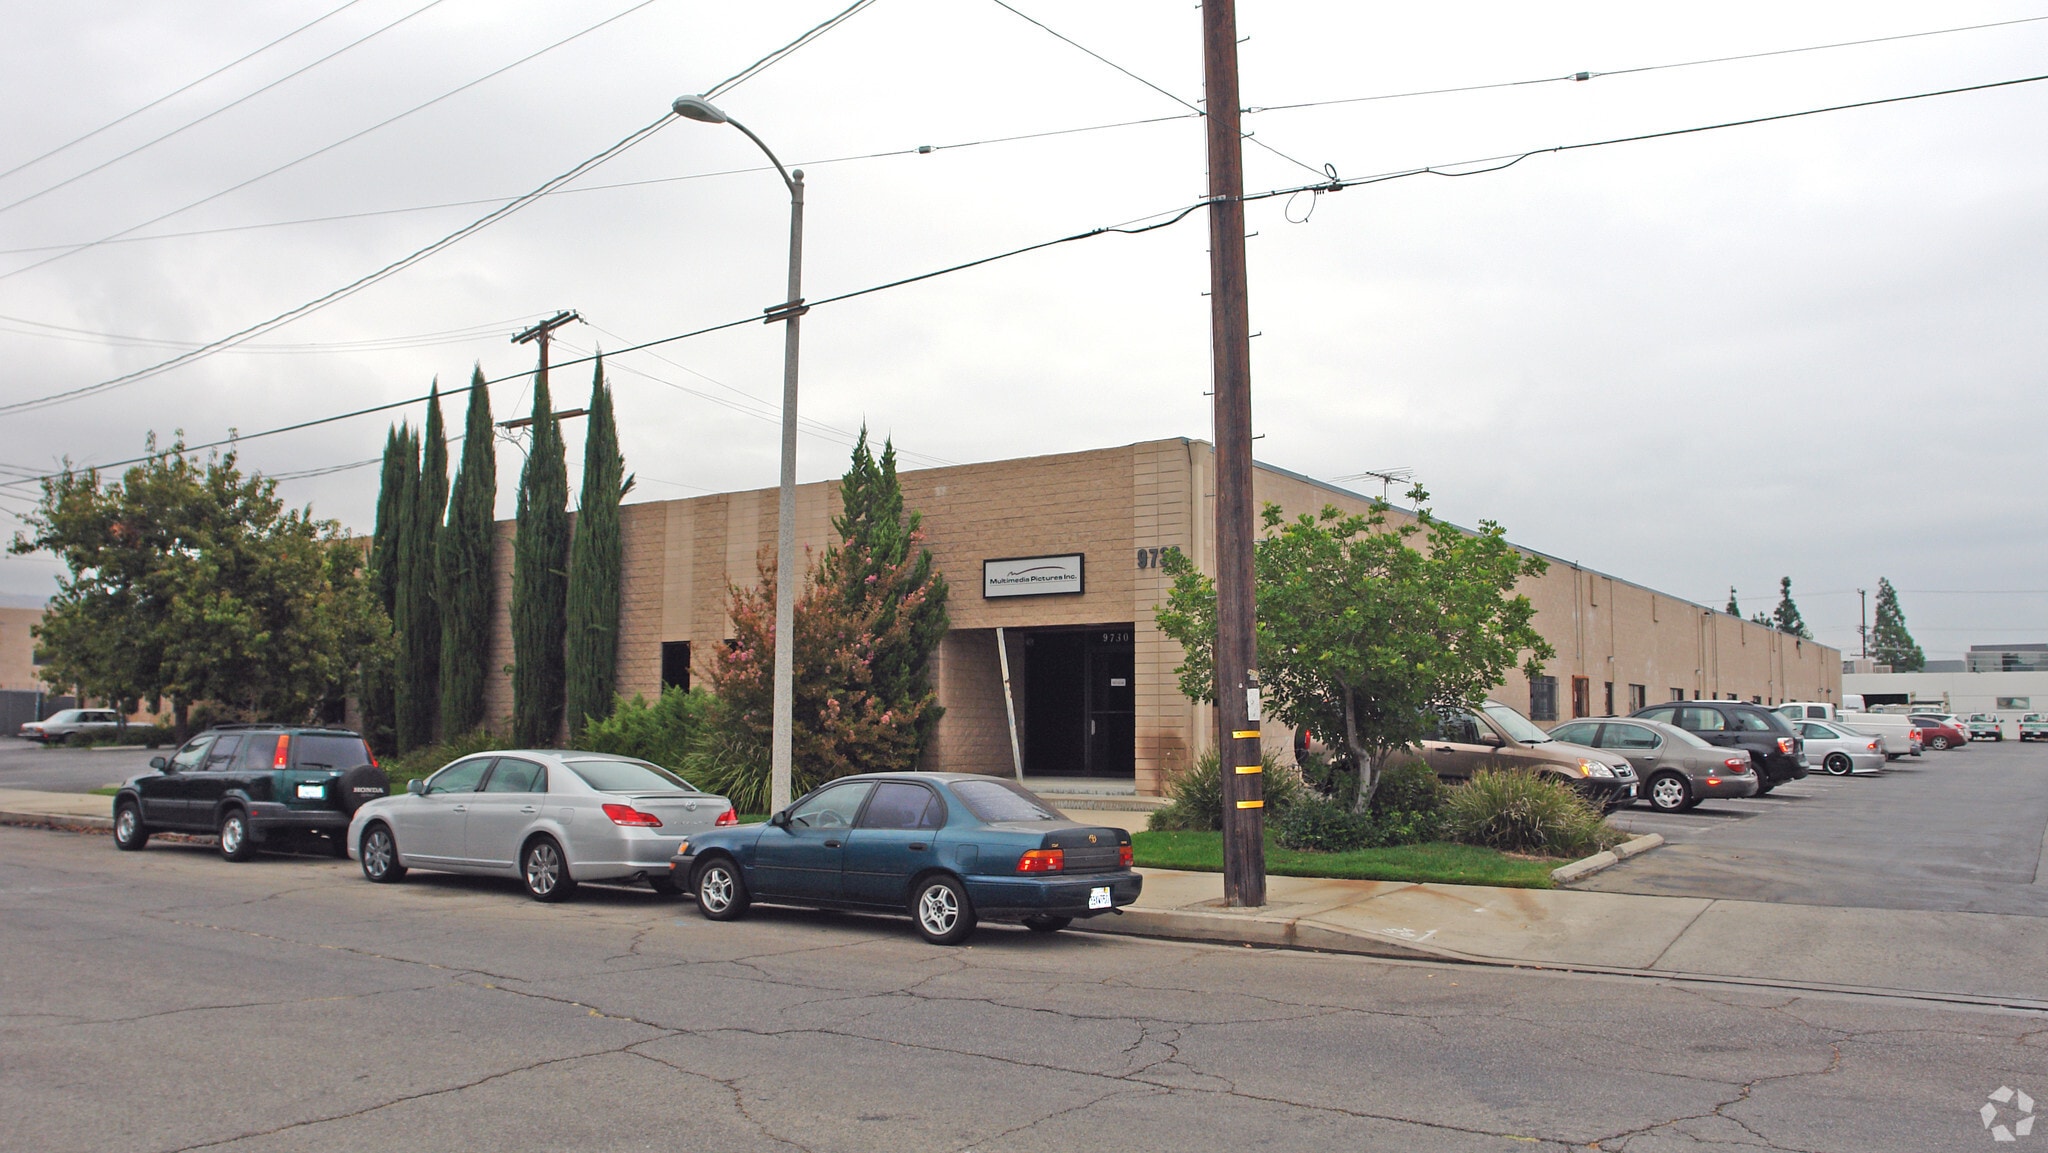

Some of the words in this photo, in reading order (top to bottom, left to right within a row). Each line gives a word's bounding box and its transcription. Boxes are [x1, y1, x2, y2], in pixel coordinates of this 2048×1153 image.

[989, 577, 1030, 585] Multimedia
[1102, 632, 1129, 643] 9730
[352, 786, 384, 794] HONDA
